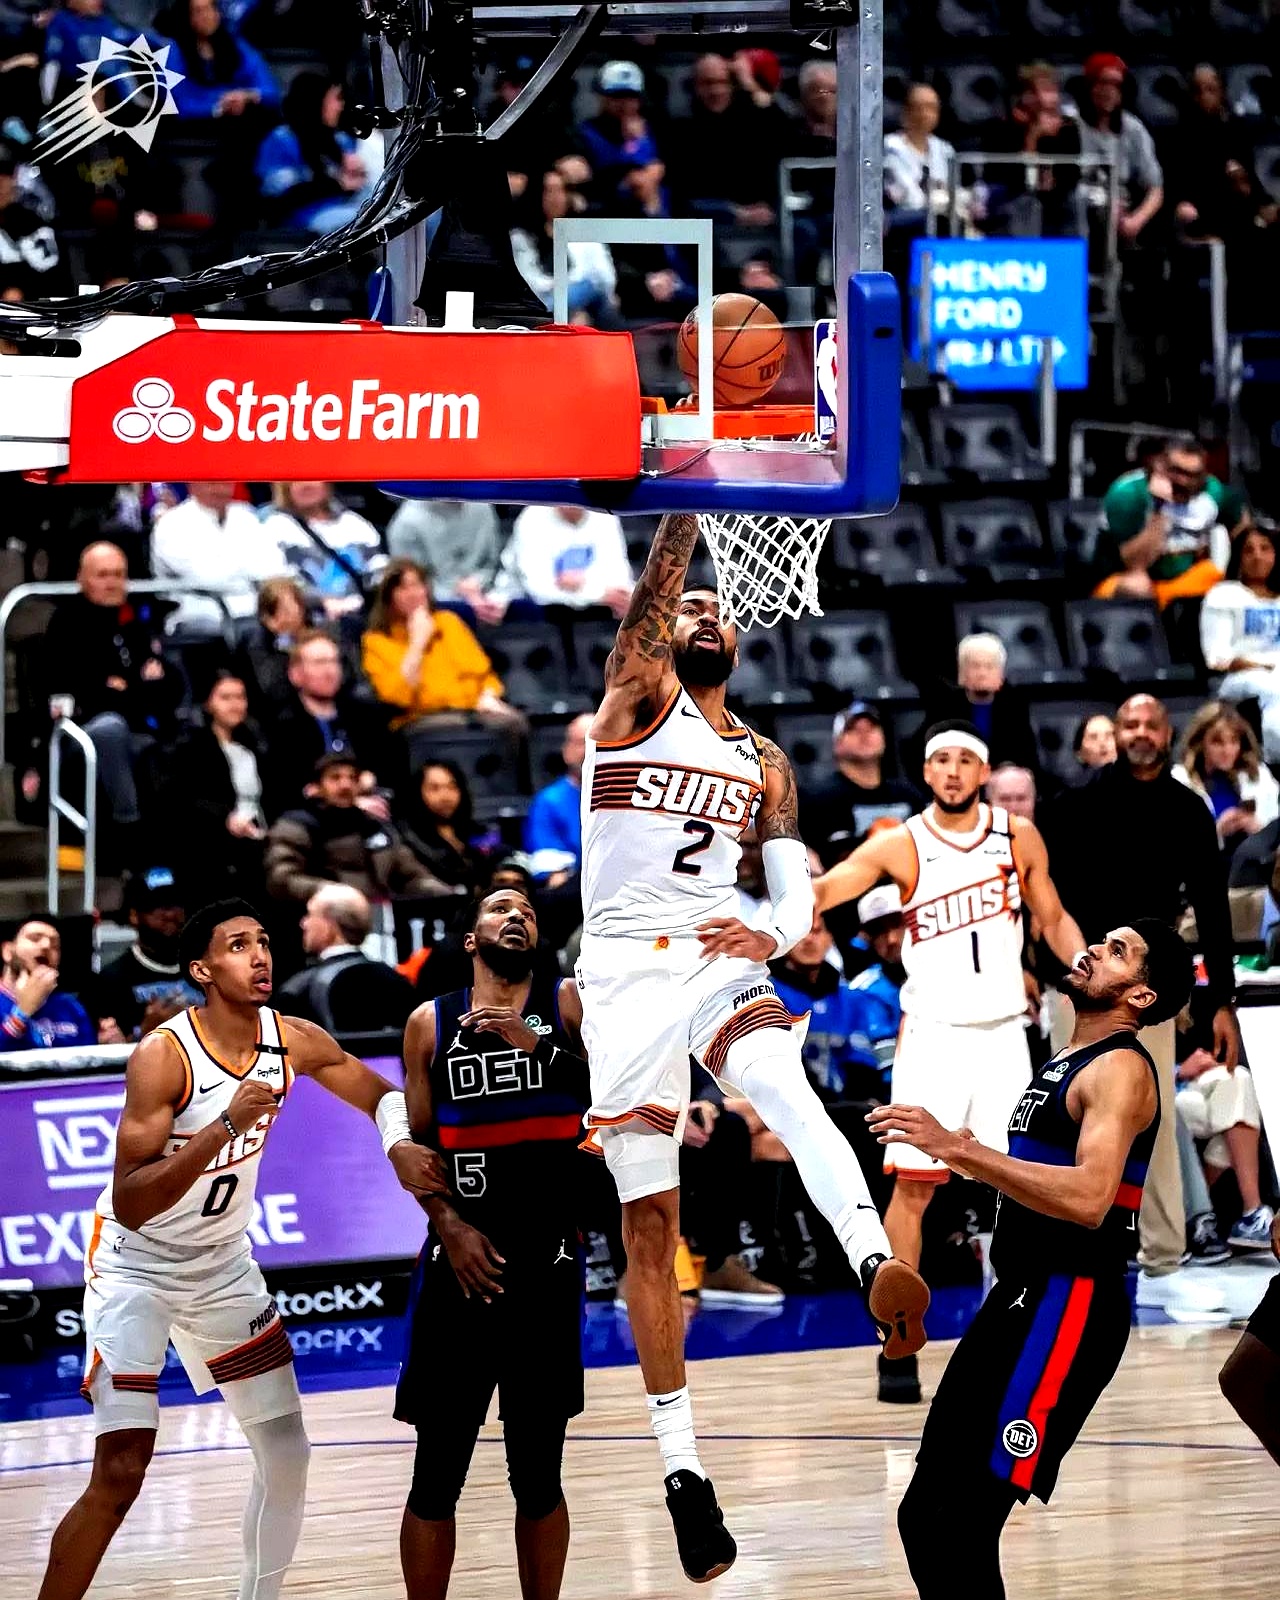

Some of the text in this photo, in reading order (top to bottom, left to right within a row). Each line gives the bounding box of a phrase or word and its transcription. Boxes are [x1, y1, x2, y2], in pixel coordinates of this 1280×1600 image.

[931, 260, 1047, 292] HENRY
[935, 296, 1022, 330] FORD
[735, 744, 760, 766] PayPa
[630, 766, 751, 823] SUNS
[672, 818, 715, 876] 2
[916, 878, 1005, 942] SUNS
[970, 930, 981, 974] 1
[257, 1065, 281, 1079] PayPal
[447, 1048, 543, 1100] DET
[1008, 1088, 1049, 1132] ET
[200, 1173, 239, 1218] 0
[454, 1153, 487, 1198] 5
[276, 1281, 385, 1317] tockX
[1009, 1428, 1033, 1449] DET
